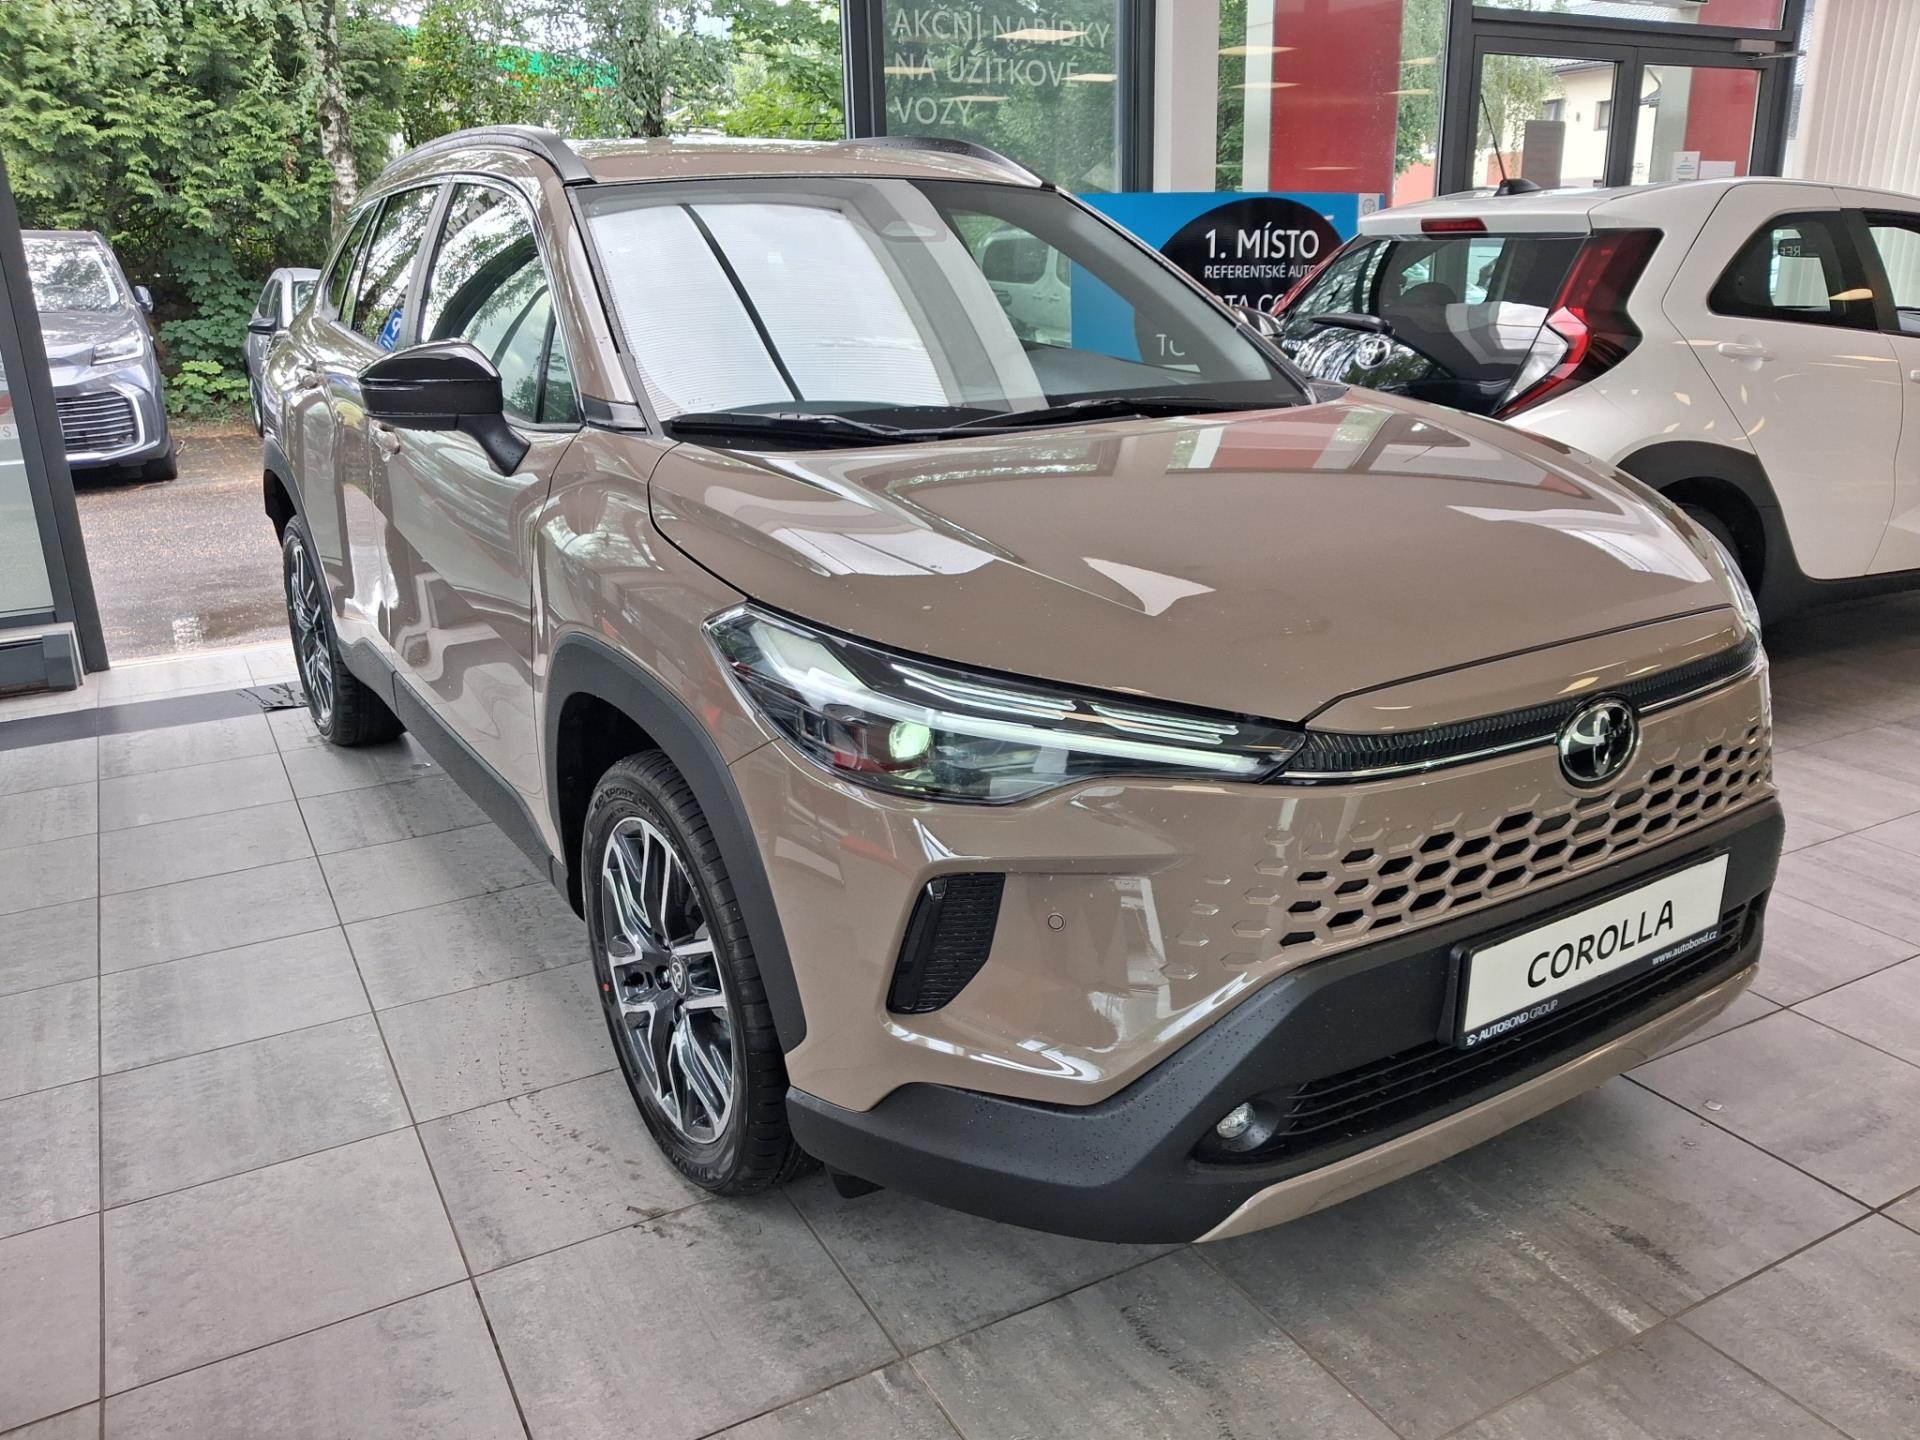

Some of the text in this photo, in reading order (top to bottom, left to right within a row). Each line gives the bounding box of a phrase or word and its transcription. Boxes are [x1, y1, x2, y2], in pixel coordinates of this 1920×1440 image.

[894, 53, 937, 82] NA
[894, 97, 973, 126] VOZY
[1205, 221, 1320, 259] 1. MÍSTO
[1204, 262, 1286, 279] REFERENTSKÉ
[1527, 899, 1674, 988] COROLLA
[1652, 931, 1718, 965] www.autobond.cz
[1479, 999, 1558, 1041] AUTOBOND GROUP
